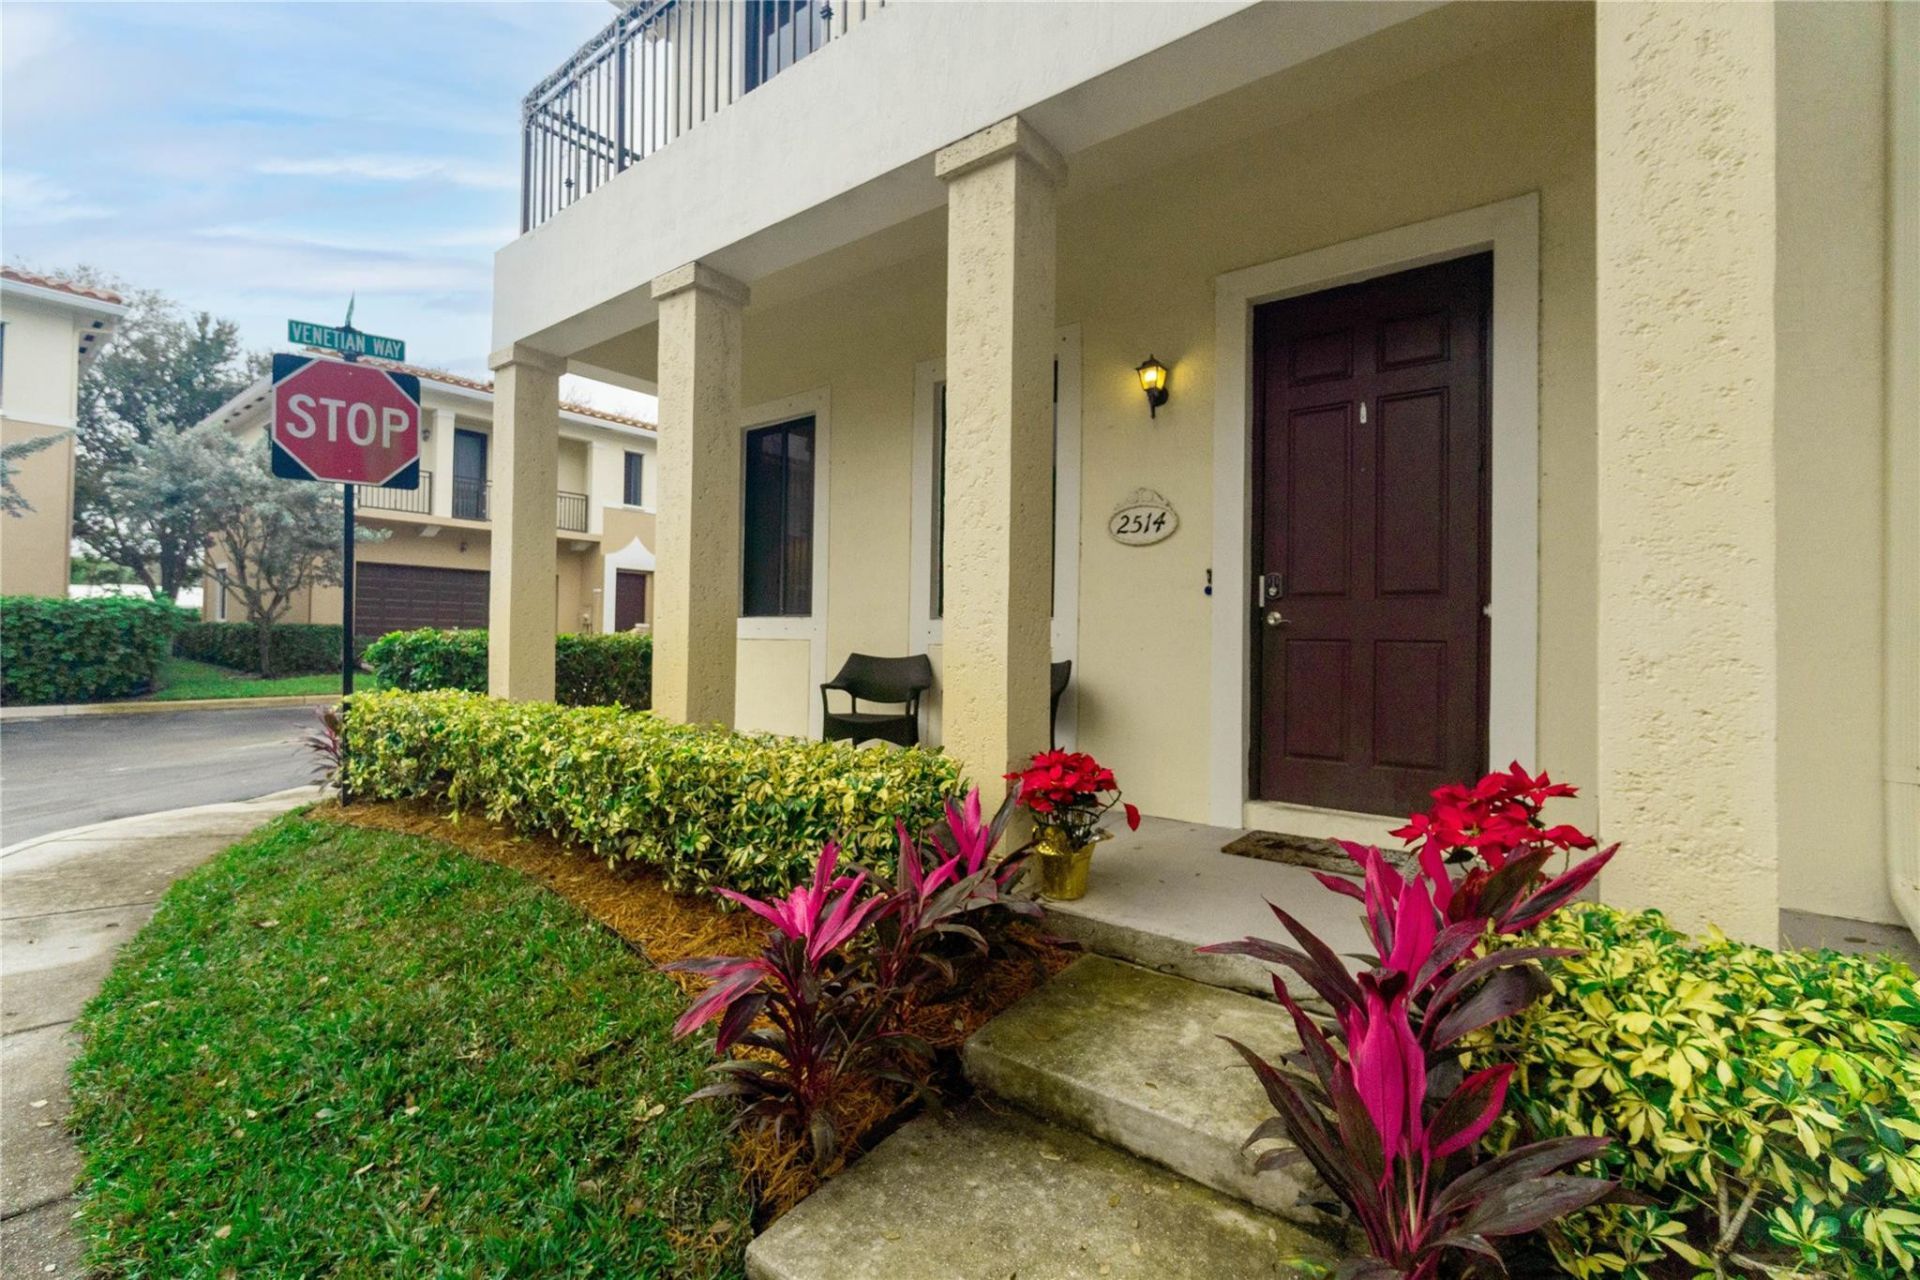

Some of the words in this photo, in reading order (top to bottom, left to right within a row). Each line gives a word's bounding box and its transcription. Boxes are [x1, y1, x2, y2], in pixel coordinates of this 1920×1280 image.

[291, 322, 366, 353] VENETIAN
[373, 338, 402, 359] WAY
[285, 393, 410, 449] STOP
[1116, 511, 1167, 535] 2514
